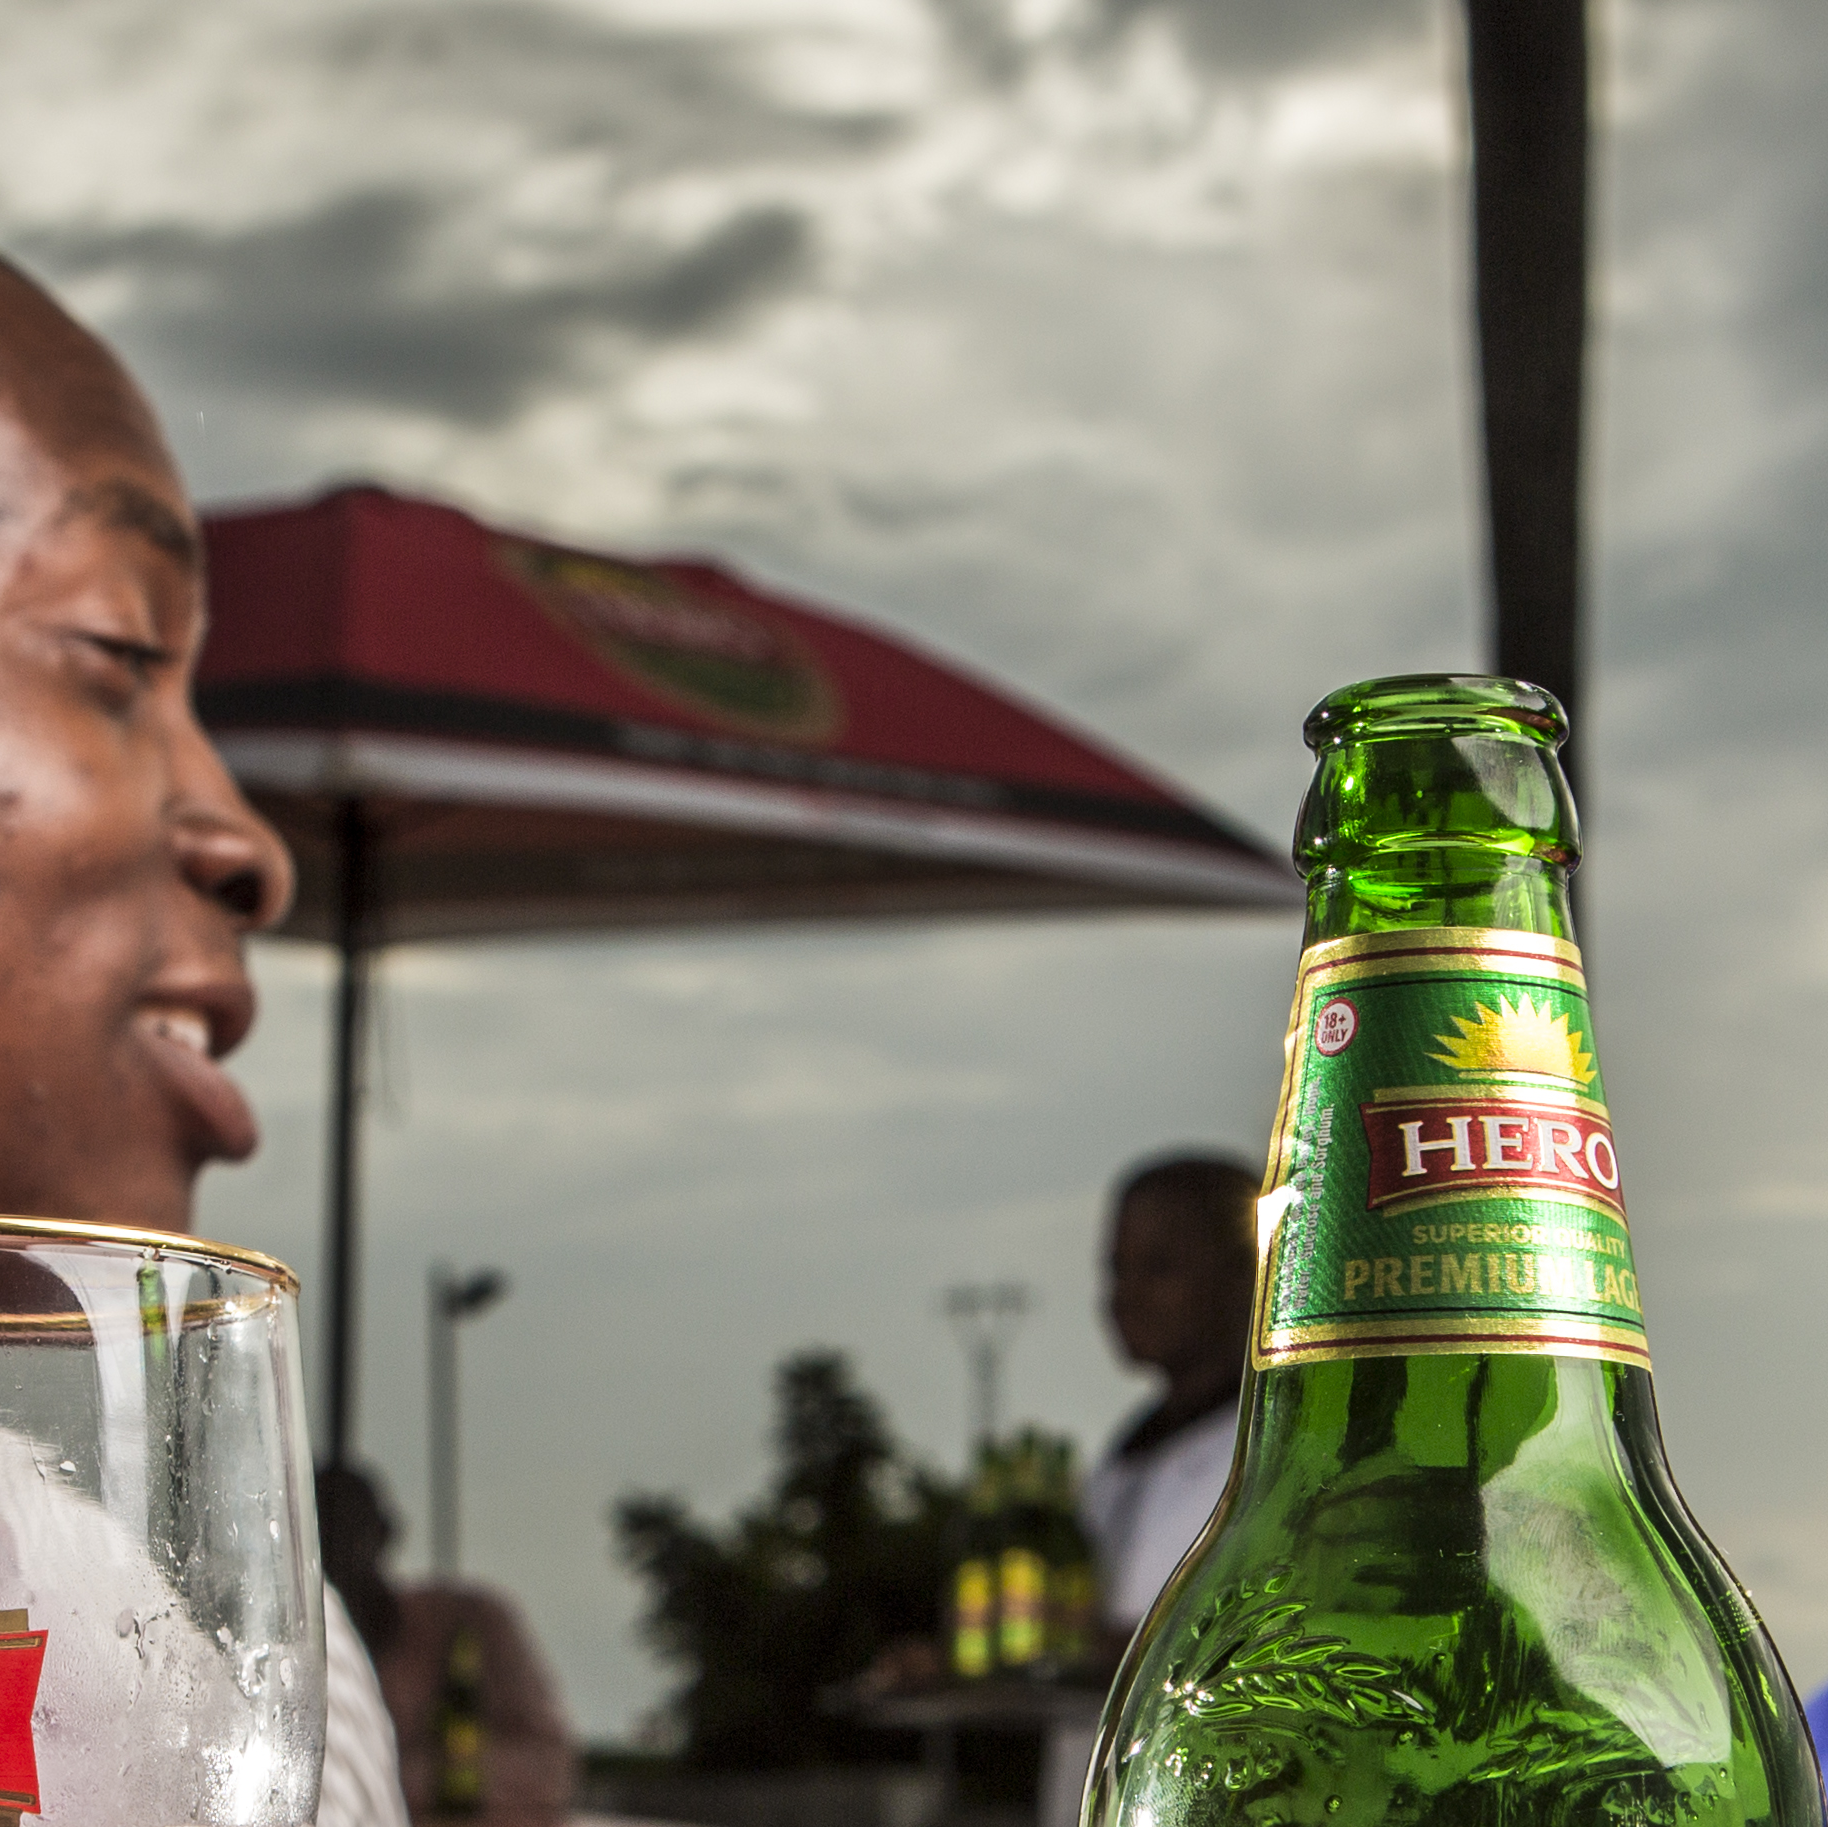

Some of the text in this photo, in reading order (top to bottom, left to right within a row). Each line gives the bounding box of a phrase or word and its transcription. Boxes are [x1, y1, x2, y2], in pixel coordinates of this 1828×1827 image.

[1321, 1028, 1349, 1043] ONLY
[1324, 1012, 1347, 1029] 18+
[1311, 1102, 1335, 1169] Sorghum.
[1398, 1115, 1620, 1190] HERO
[1309, 1174, 1325, 1200] and
[1299, 1204, 1321, 1259] Sucrose
[1413, 1224, 1626, 1260] SUPERIOR QUALITY
[1343, 1252, 1573, 1301] PREMIUM
